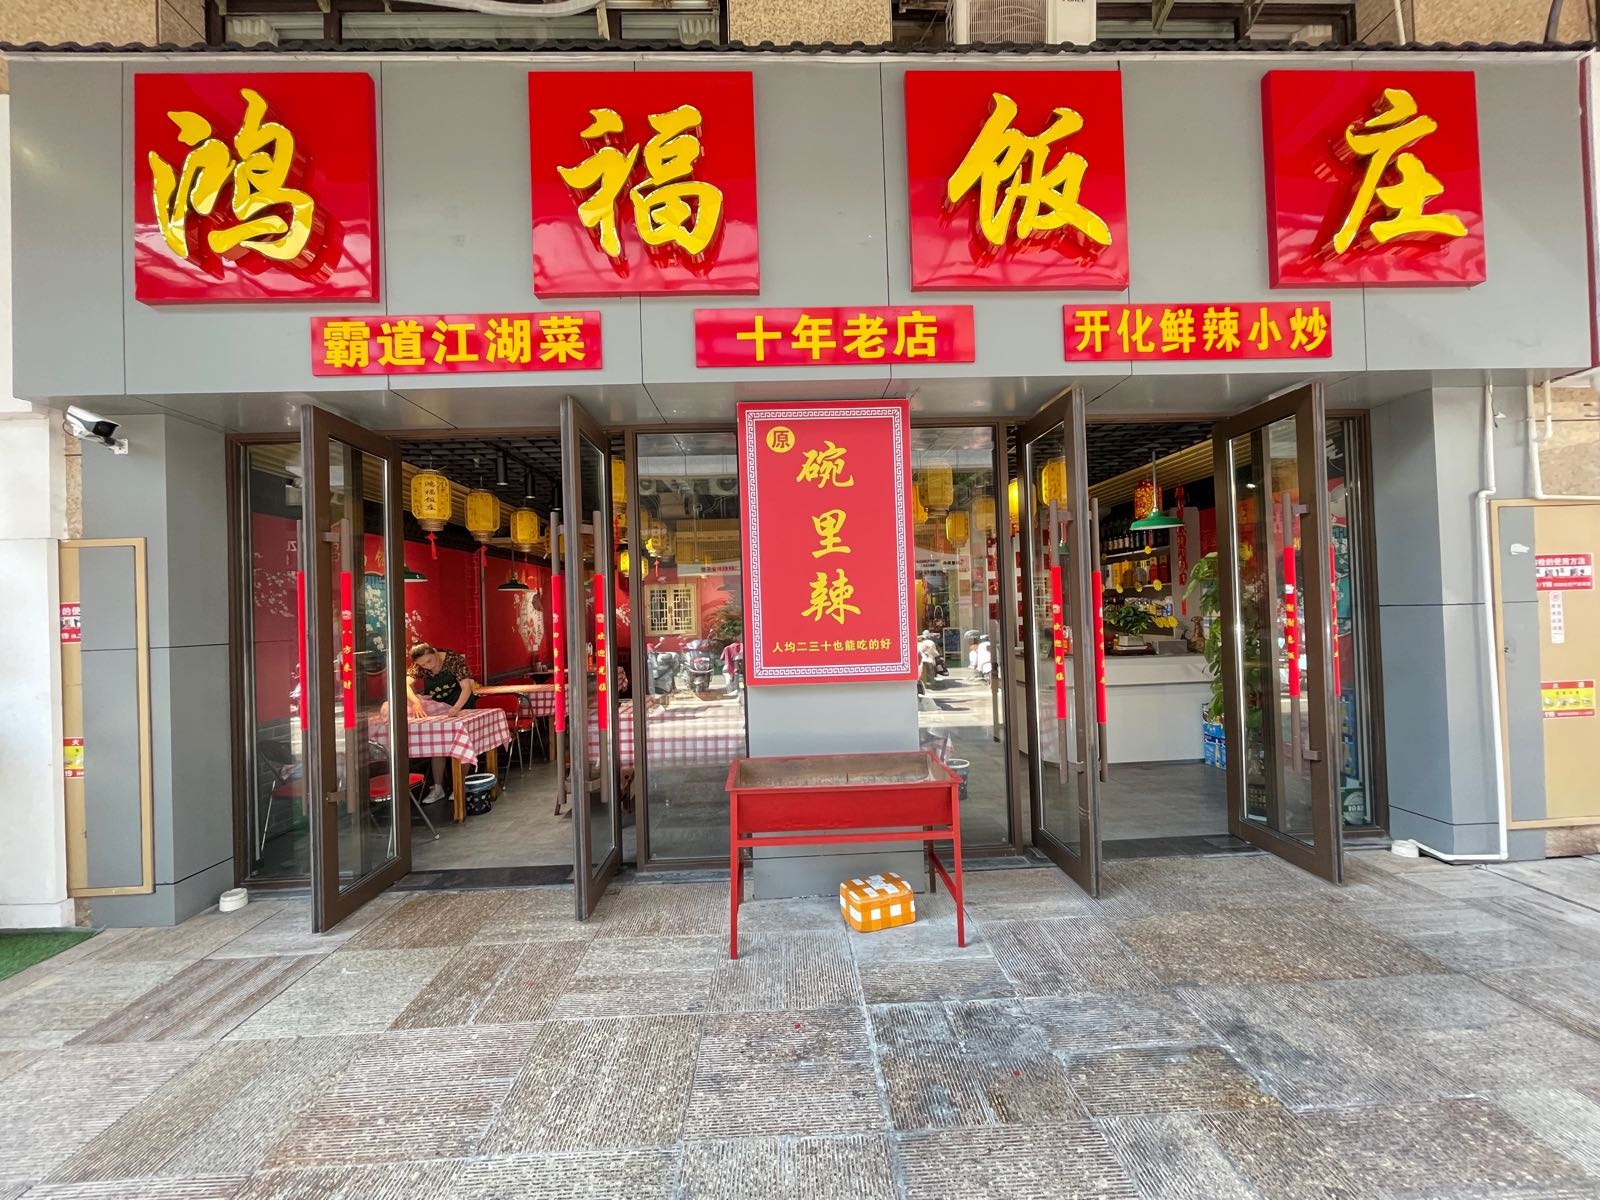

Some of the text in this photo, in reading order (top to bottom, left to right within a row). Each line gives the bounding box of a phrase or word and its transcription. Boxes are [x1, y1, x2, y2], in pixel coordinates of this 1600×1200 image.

[323, 316, 585, 368] 霸道江湖菜
[736, 310, 938, 361] 十年老店
[1074, 307, 1328, 353] 开化鲜辣小炒
[771, 430, 791, 449] 原
[796, 440, 861, 625] 碗里辣
[772, 638, 892, 653] 人均二三十也能吃的好
